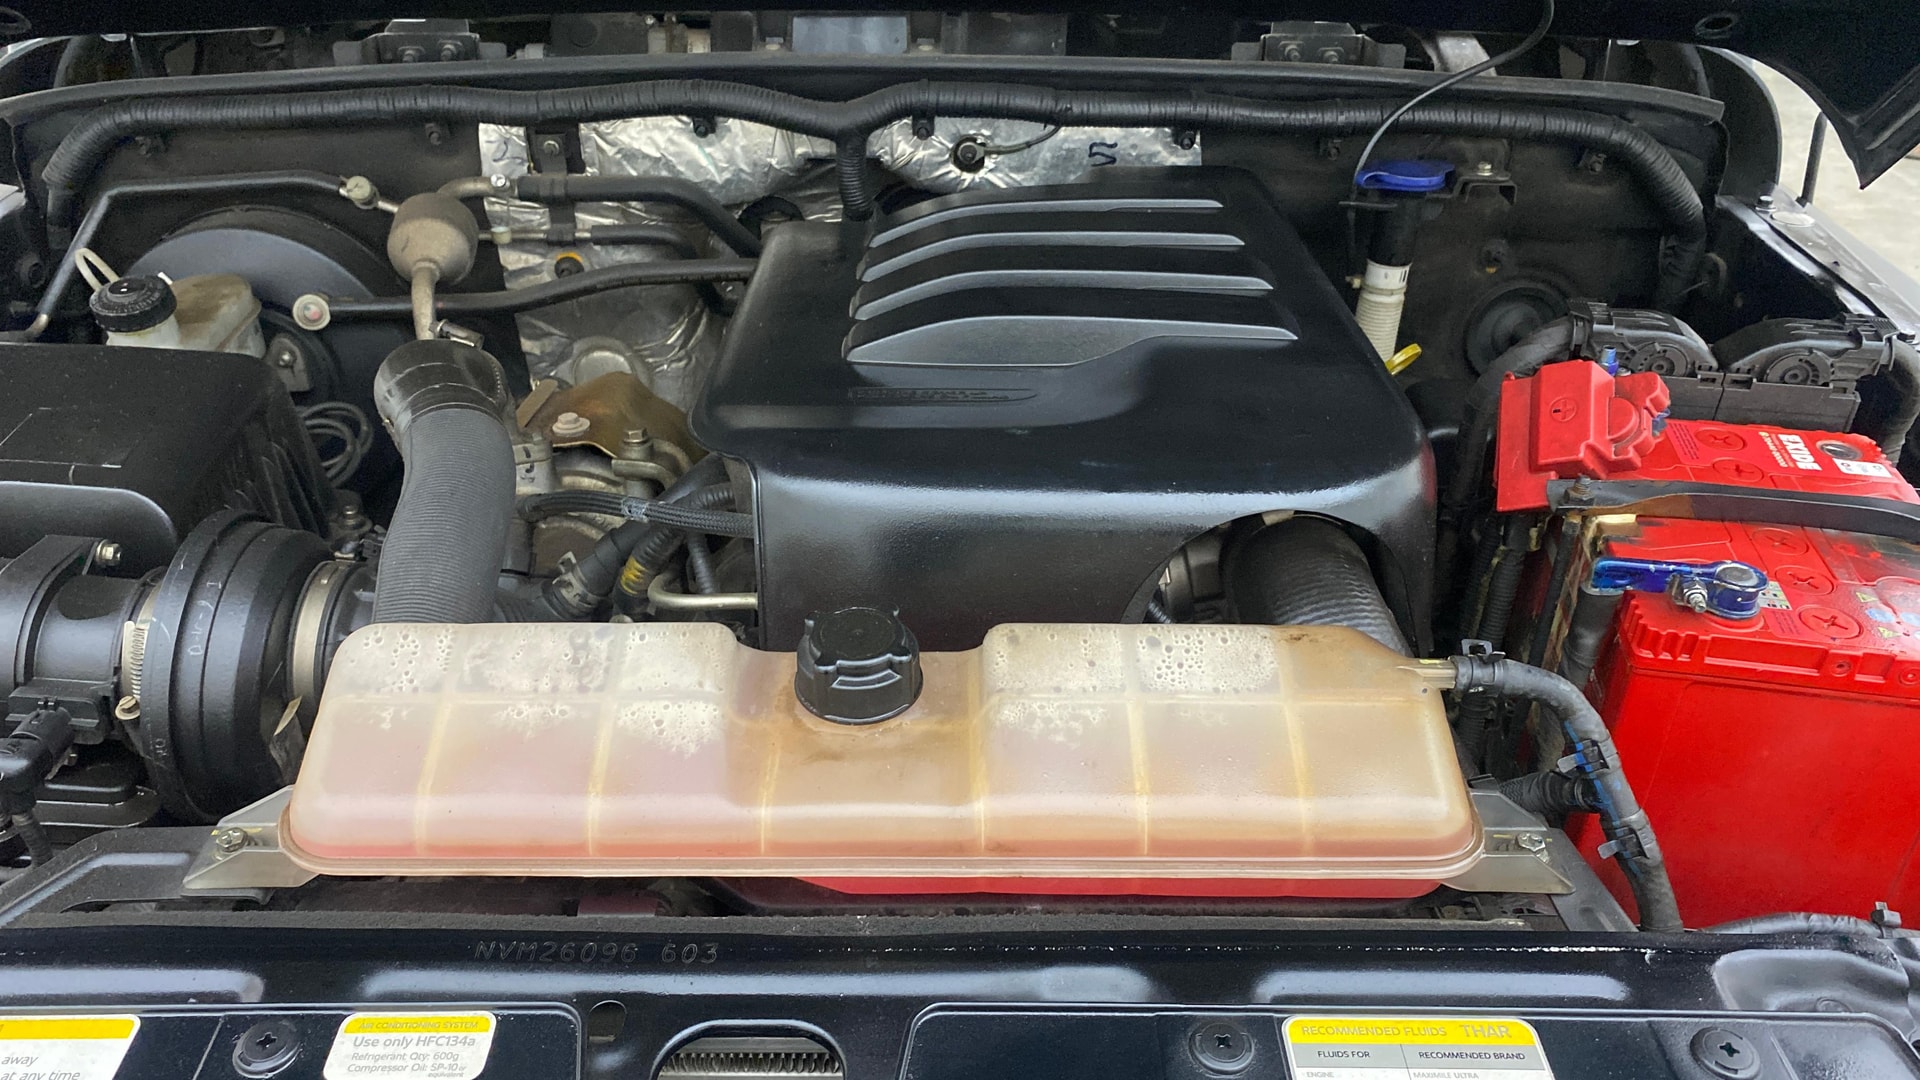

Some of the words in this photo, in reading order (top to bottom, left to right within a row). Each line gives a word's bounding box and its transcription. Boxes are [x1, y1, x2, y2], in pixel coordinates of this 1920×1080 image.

[1777, 433, 1823, 471] EXIDE
[474, 940, 637, 963] NVM26096
[661, 942, 719, 964] 603
[375, 1021, 441, 1029] CONDITIONING
[442, 1021, 478, 1029] SYSTEM
[1301, 1025, 1401, 1036] RECOMMENDED
[1403, 1026, 1447, 1037] FLUIDS
[1459, 1023, 1512, 1039] THAR
[353, 1036, 380, 1047] Use
[383, 1036, 413, 1050] only
[415, 1035, 476, 1047] HFC134a
[351, 1052, 407, 1062] Refrigerant
[432, 1051, 460, 1062] 600g
[1317, 1050, 1350, 1058] FLUIDS
[1351, 1050, 1370, 1058] FOR
[1418, 1051, 1492, 1060] RECOMMENDED
[1493, 1052, 1526, 1060] BRAND
[1, 1056, 39, 1067] away
[347, 1063, 408, 1074] Compressor
[411, 1062, 428, 1071] Oil:
[430, 1062, 459, 1071] SP-10
[0, 1072, 18, 1080] at
[19, 1072, 47, 1080] any
[48, 1070, 81, 1080] time
